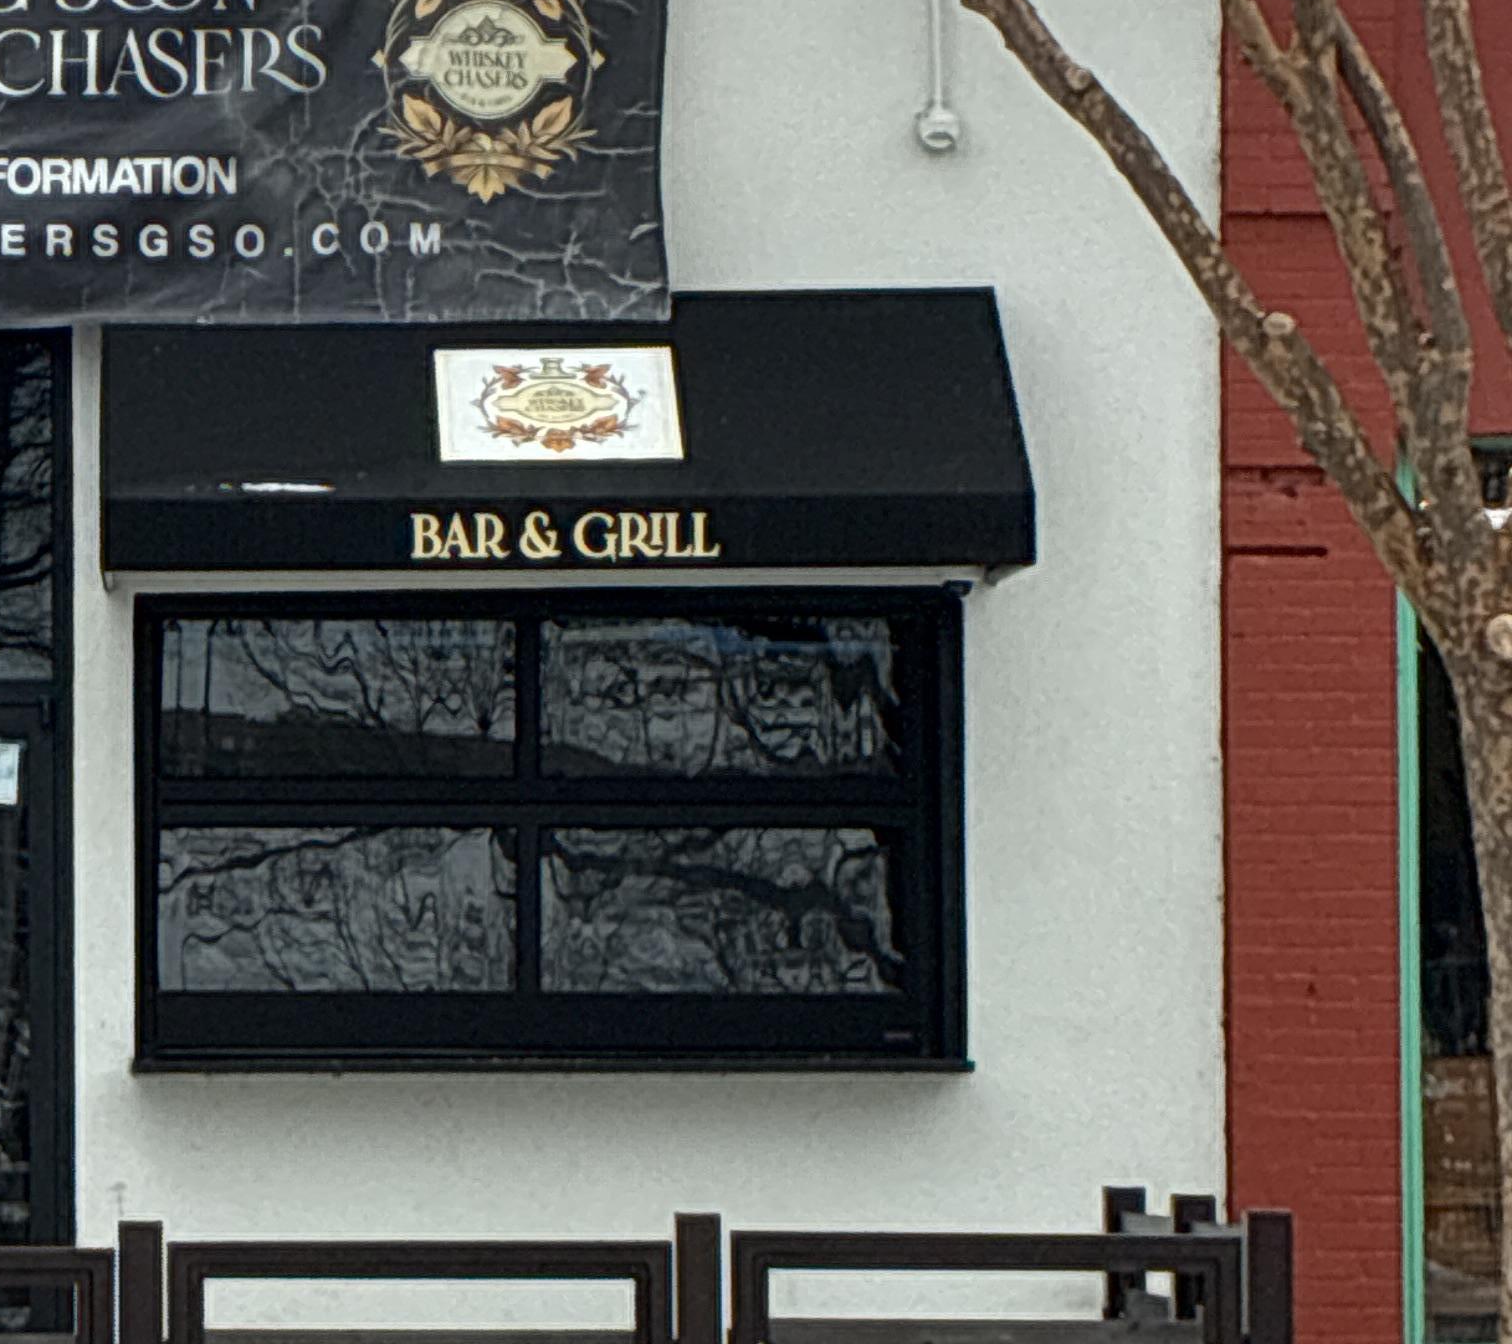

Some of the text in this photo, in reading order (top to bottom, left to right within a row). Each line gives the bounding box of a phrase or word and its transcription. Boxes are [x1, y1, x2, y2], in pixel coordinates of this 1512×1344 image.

[410, 510, 720, 562] BAR & GRILL
